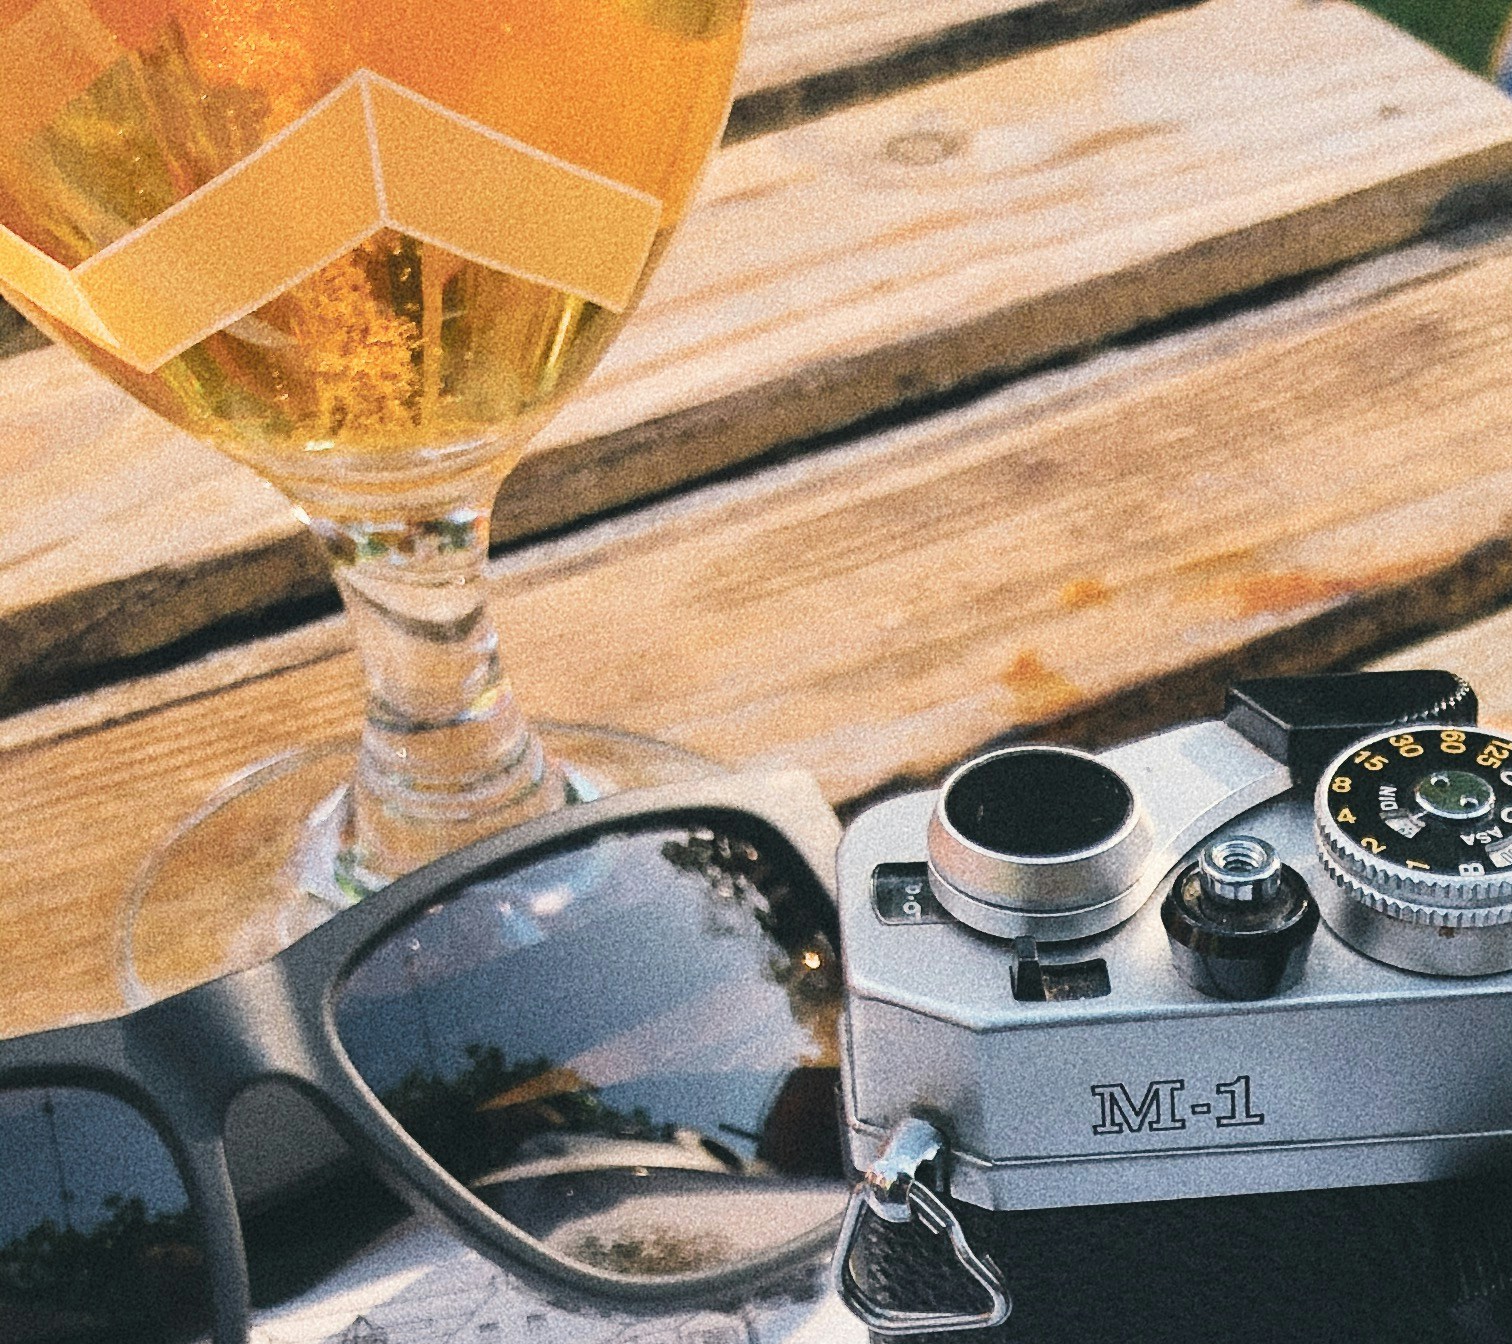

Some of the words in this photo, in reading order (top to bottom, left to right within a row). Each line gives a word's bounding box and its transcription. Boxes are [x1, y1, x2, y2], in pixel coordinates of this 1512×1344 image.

[1389, 734, 1424, 758] 30
[1440, 730, 1466, 754] 60
[1353, 750, 1389, 771] 15
[1331, 776, 1352, 793] 8
[1378, 785, 1397, 811] DIN
[1337, 807, 1357, 824] 4
[1459, 825, 1503, 845] ASA
[1360, 837, 1386, 854] 2
[1458, 862, 1485, 876] B
[1092, 1074, 1265, 1136] M-1
